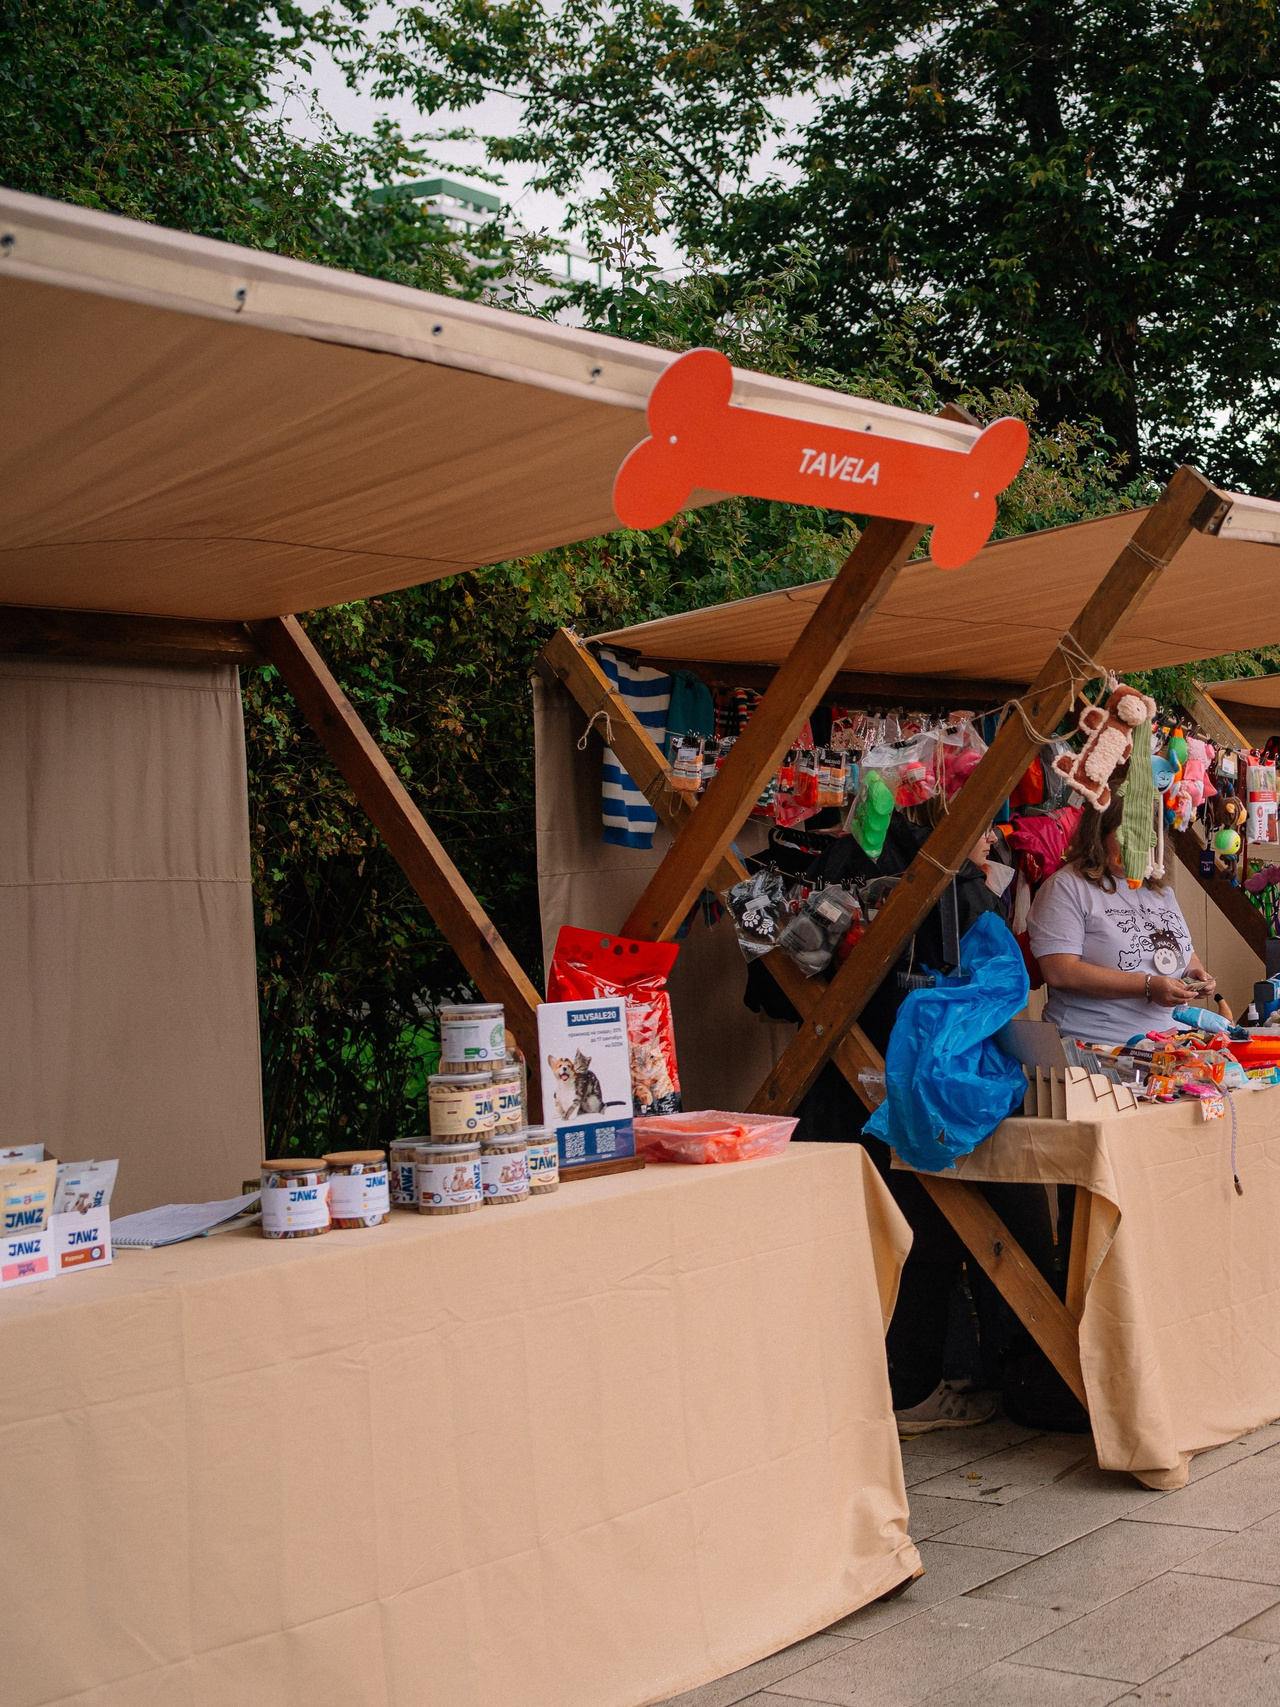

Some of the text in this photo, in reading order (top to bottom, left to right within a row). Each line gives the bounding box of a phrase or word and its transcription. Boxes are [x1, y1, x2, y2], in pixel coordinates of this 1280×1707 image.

[798, 448, 881, 486] TAVELA
[1156, 940, 1182, 958] УЧАСТНИК
[571, 1010, 617, 1023] JULYSALE20
[365, 1175, 386, 1188] JAWZ
[401, 1166, 414, 1202] JAWZ
[289, 1189, 318, 1202] JAWZ
[5, 1208, 45, 1228] JAWZ
[67, 1228, 99, 1246] JAWZ
[8, 1239, 41, 1257] JAWZ
